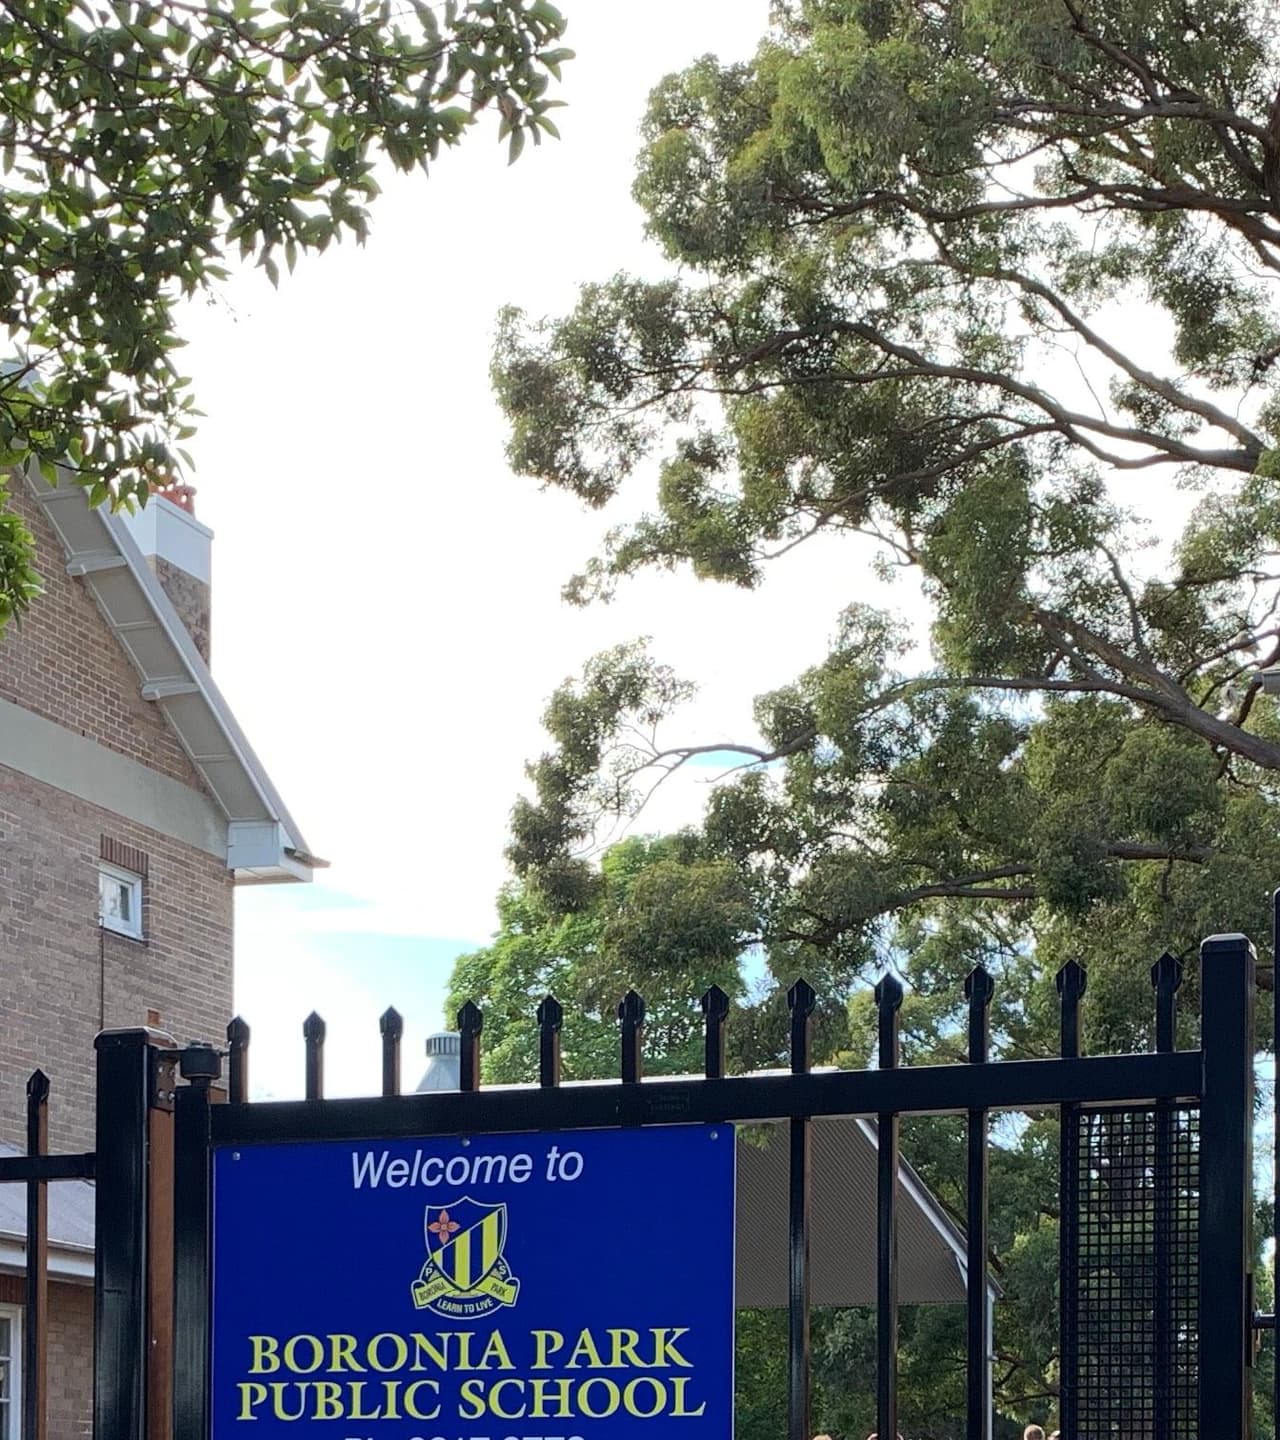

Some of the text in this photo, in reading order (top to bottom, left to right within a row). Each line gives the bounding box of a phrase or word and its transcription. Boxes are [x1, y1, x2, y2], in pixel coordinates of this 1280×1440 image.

[352, 1145, 584, 1189] Welcome to
[437, 1298, 494, 1314] LEARN TO LIVE
[248, 1327, 694, 1374] BORONIA PARK
[236, 1376, 706, 1421] PUBLIC SCHOOL
